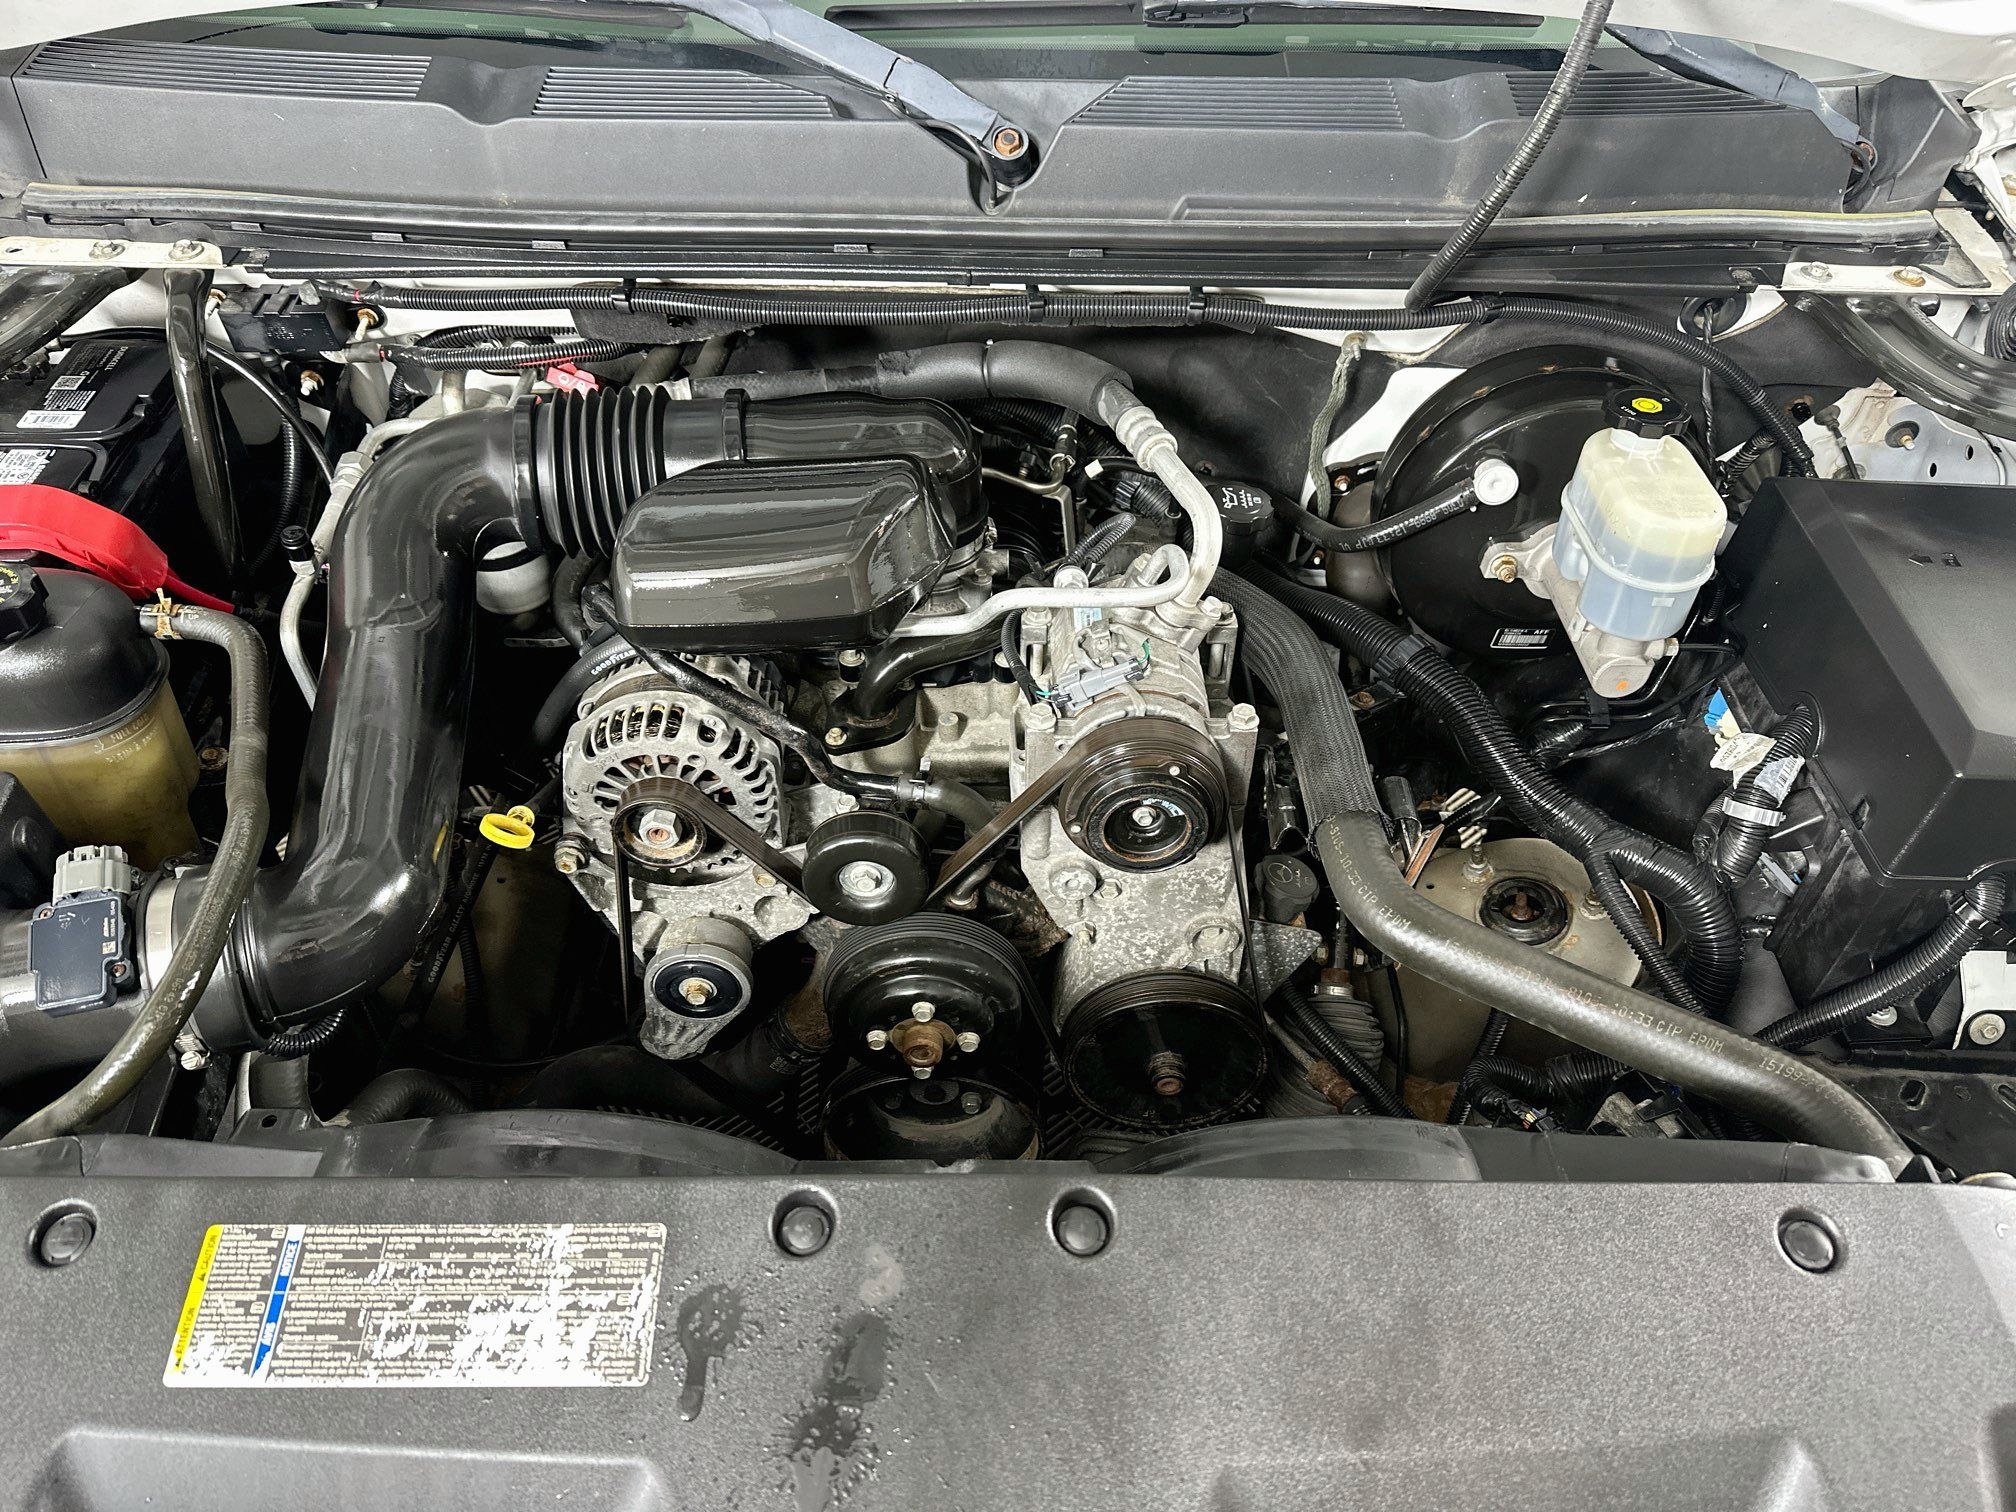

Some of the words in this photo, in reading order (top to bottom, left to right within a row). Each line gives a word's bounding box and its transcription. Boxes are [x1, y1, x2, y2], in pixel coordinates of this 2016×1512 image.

[105, 346, 129, 371] DURACELL
[591, 649, 637, 676] GOODYEAR
[1358, 882, 1379, 905] CIP
[1656, 1020, 1683, 1038] CIP
[1687, 1032, 1726, 1054] EPDM
[201, 1234, 217, 1271] CAUTION
[279, 1242, 299, 1276] NOTICE
[178, 1307, 195, 1355] ATTENTION
[261, 1322, 276, 1346] AVIS
